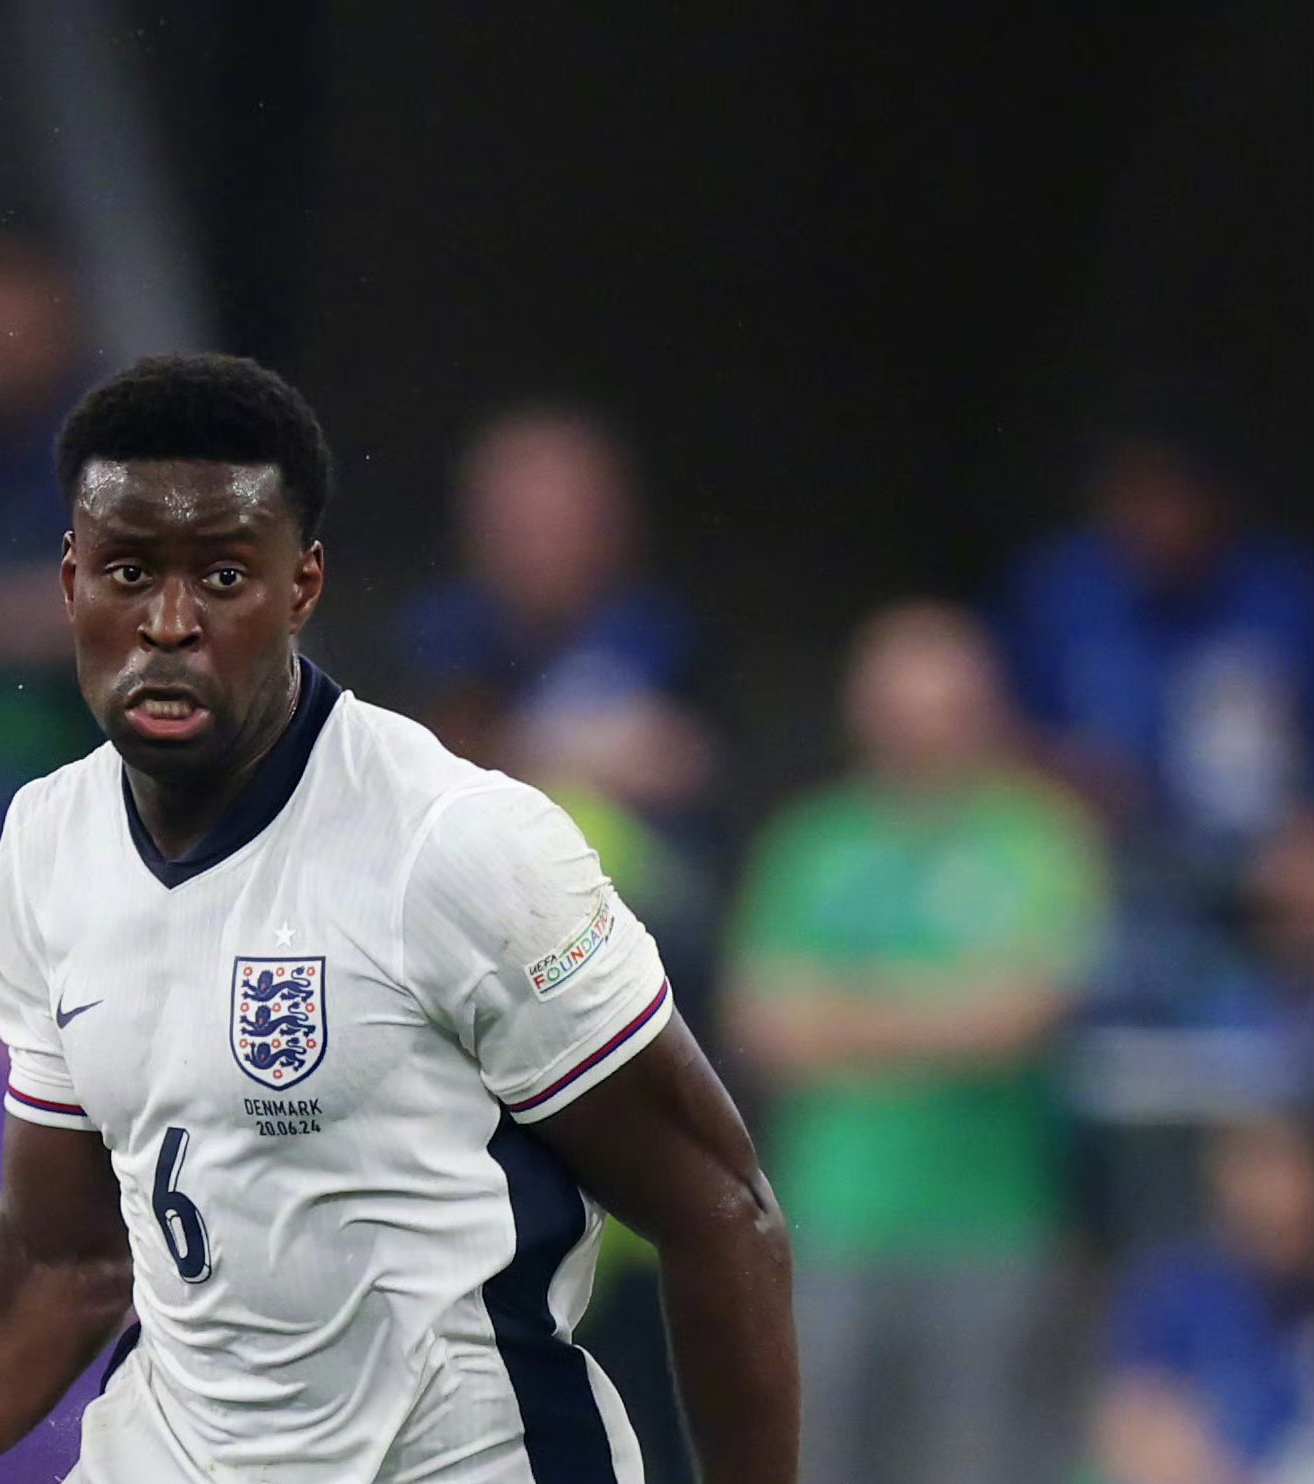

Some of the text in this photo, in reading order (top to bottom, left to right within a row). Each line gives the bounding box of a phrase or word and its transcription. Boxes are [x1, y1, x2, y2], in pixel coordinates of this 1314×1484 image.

[529, 954, 557, 975] UEFA
[244, 1098, 323, 1117] DENMARK
[256, 1119, 321, 1136] 20.06.24
[152, 1127, 212, 1284] 6
